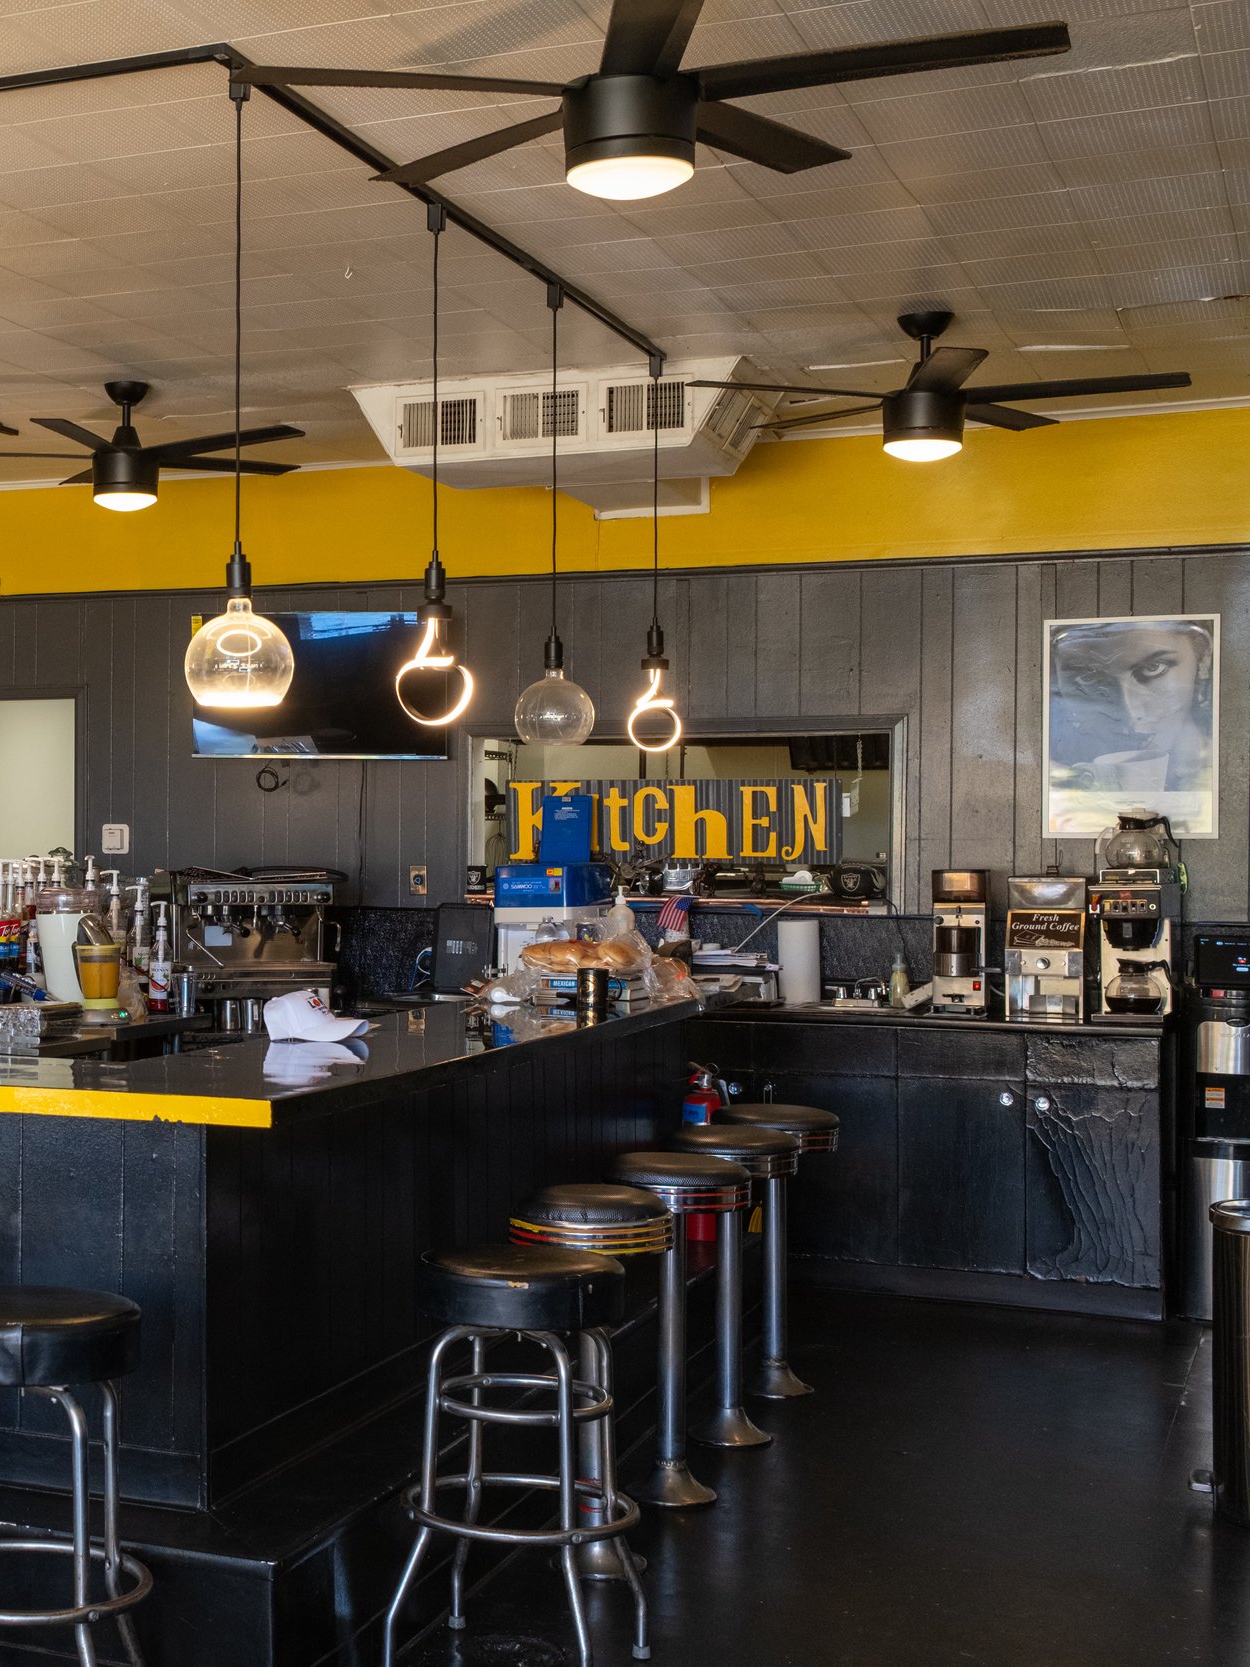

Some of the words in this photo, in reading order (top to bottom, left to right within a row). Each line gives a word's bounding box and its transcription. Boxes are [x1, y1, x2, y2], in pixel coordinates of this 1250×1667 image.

[1032, 913, 1059, 921] Fresh
[1011, 922, 1048, 930] Ground
[1049, 922, 1080, 932] Coffee
